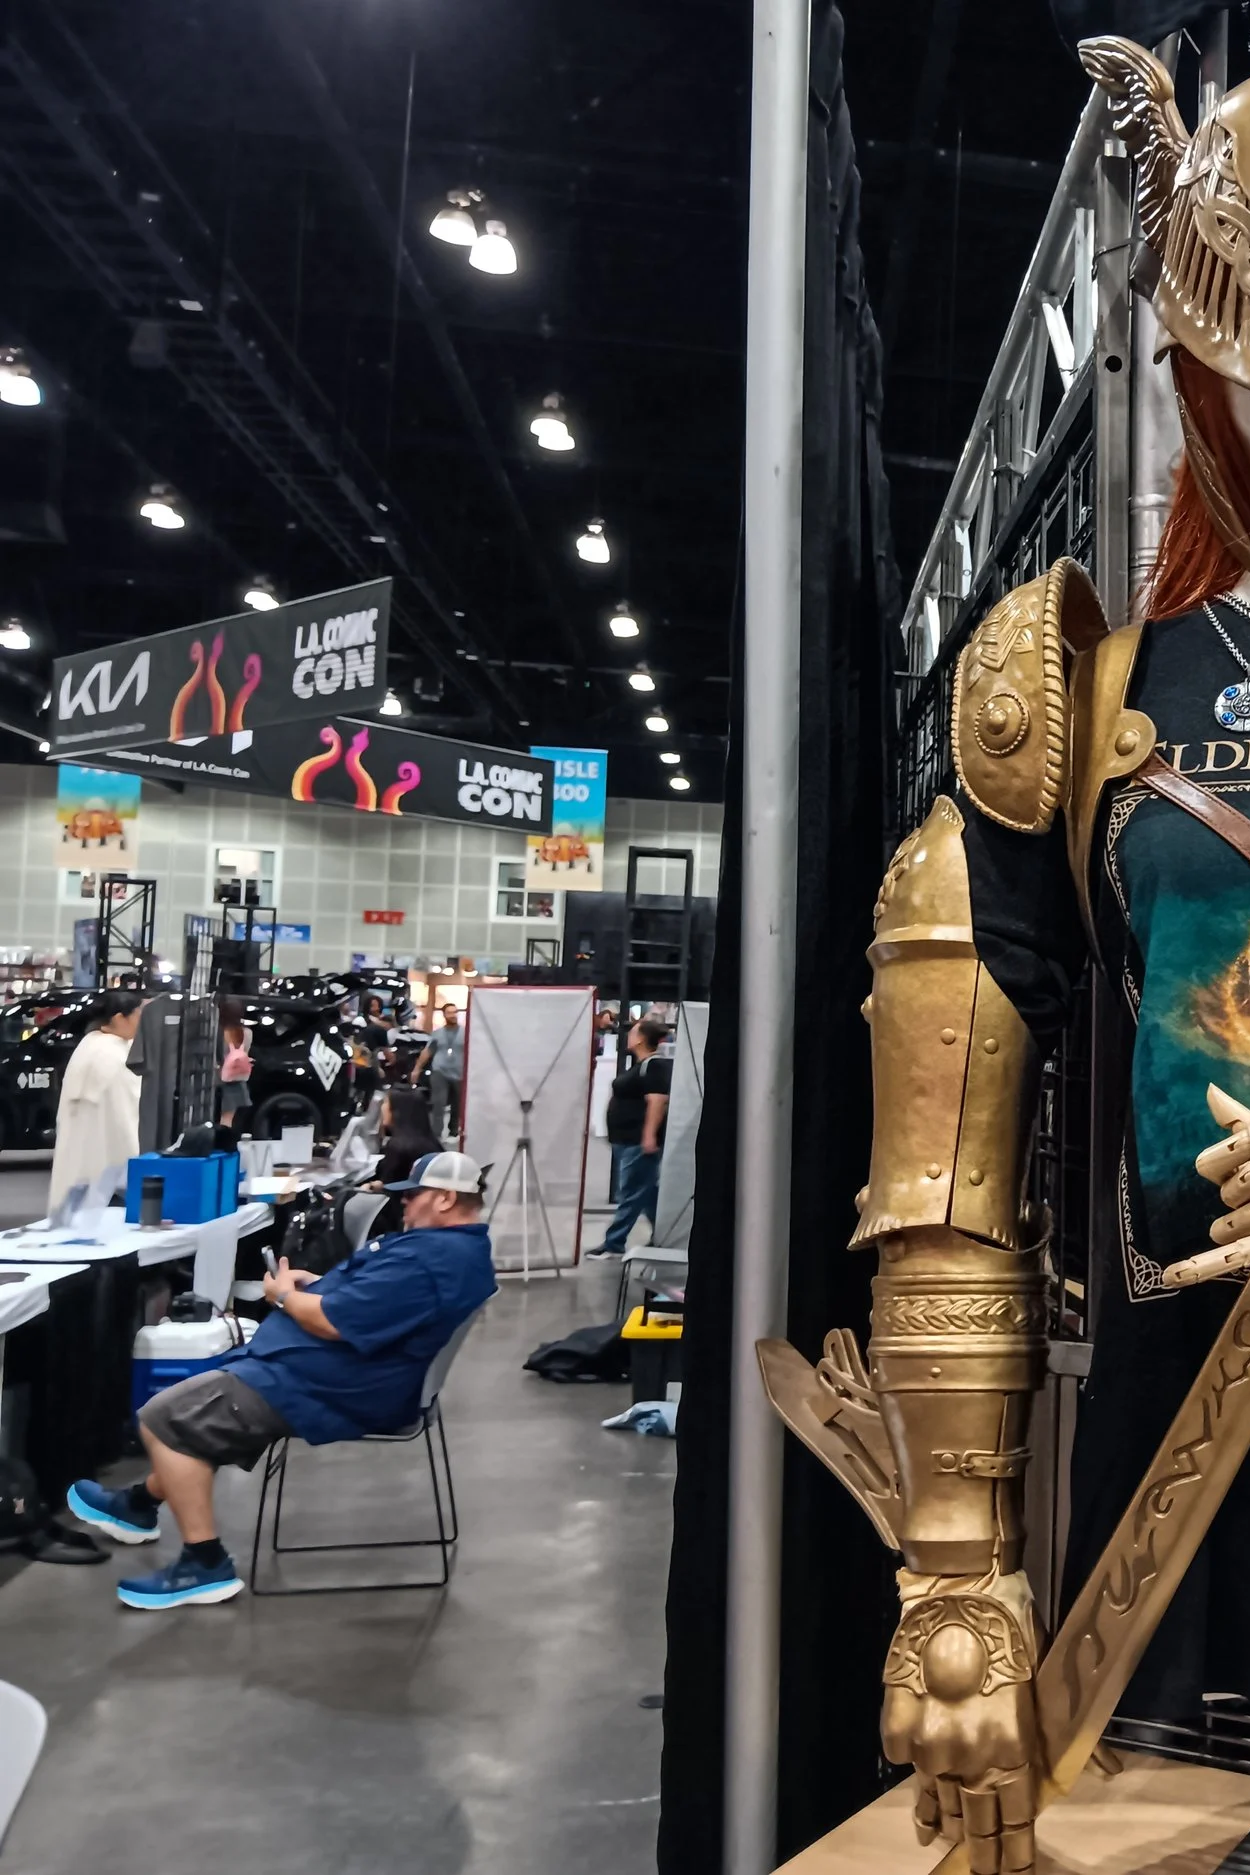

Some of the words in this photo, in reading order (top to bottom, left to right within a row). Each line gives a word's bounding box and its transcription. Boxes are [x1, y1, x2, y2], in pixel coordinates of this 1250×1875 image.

[292, 645, 376, 699] CON
[553, 760, 599, 779] ISLE
[457, 783, 543, 822] CON
